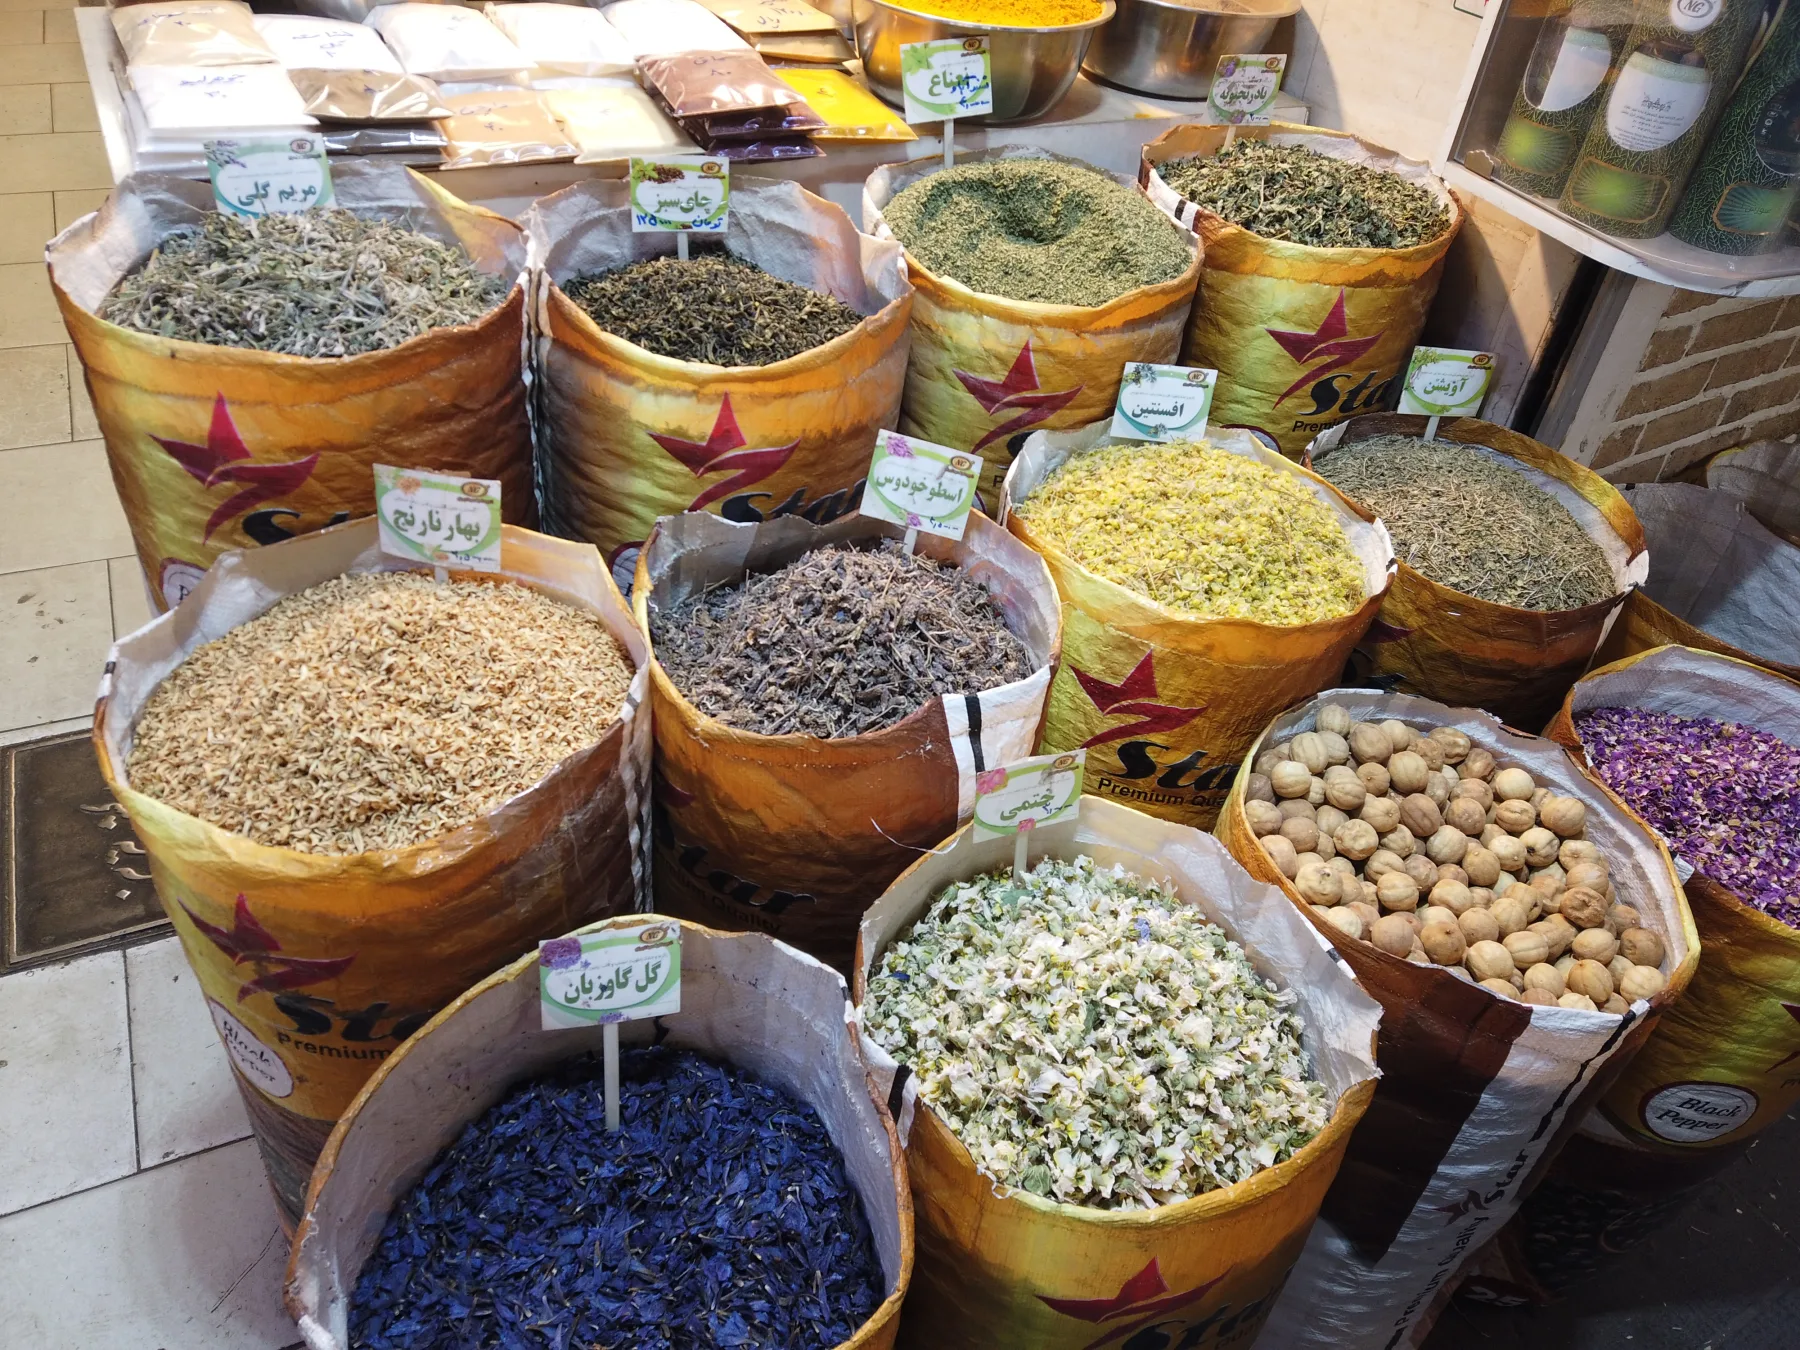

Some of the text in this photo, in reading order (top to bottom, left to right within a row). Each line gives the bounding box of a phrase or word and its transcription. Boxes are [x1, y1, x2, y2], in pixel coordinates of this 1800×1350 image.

[928, 67, 970, 97] نعناع
[238, 180, 317, 207] مریم گلی
[654, 190, 713, 215] چای سبز
[1296, 370, 1399, 416] Sta
[1131, 400, 1185, 419] افسنتین
[392, 503, 442, 537] نارنج
[443, 512, 480, 544] بهار
[1098, 739, 1242, 792] Sta
[1000, 787, 1056, 822] ختمی
[1097, 776, 1185, 806] Premium
[564, 959, 662, 1005] گل گاوزبان
[1655, 1109, 1730, 1130] Pepper
[1677, 1097, 1742, 1118] Black
[1484, 1148, 1529, 1204] Star
[1438, 1216, 1490, 1268] Quality
